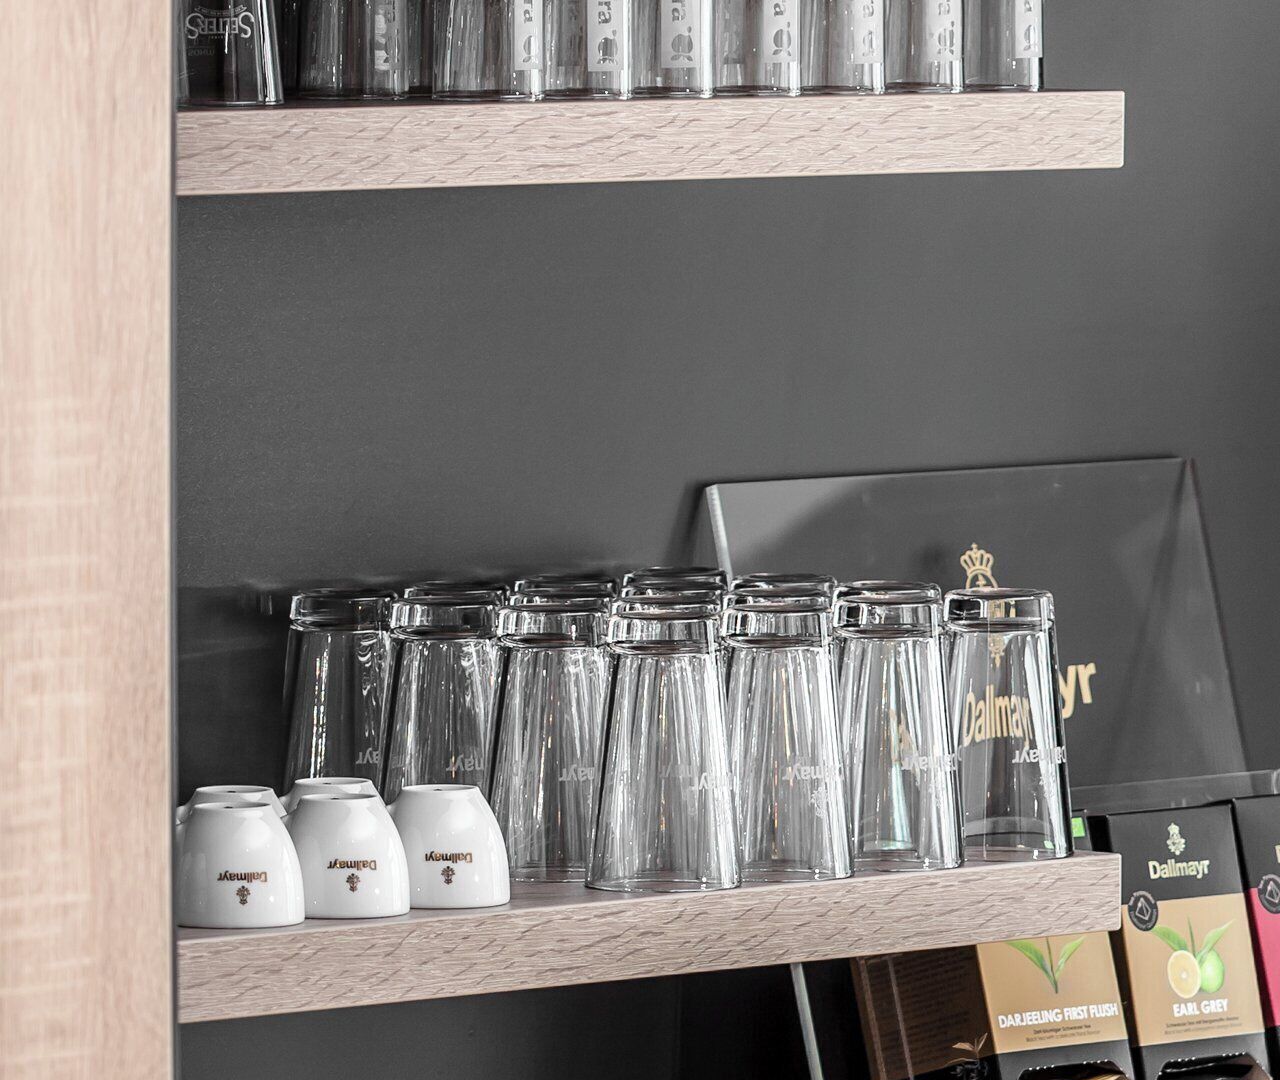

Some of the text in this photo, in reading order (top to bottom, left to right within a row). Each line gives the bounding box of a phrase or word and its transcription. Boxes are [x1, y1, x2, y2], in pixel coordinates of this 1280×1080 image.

[185, 12, 255, 38] SELTERS
[327, 857, 378, 872] Dallmayr
[424, 850, 473, 865] Dallmayr
[217, 870, 268, 883] Dallmayr
[1147, 858, 1210, 880] Dallmayr
[997, 1002, 1120, 1029] DARJEELING FIRST FLUSH
[1172, 997, 1229, 1018] EARL GREY
